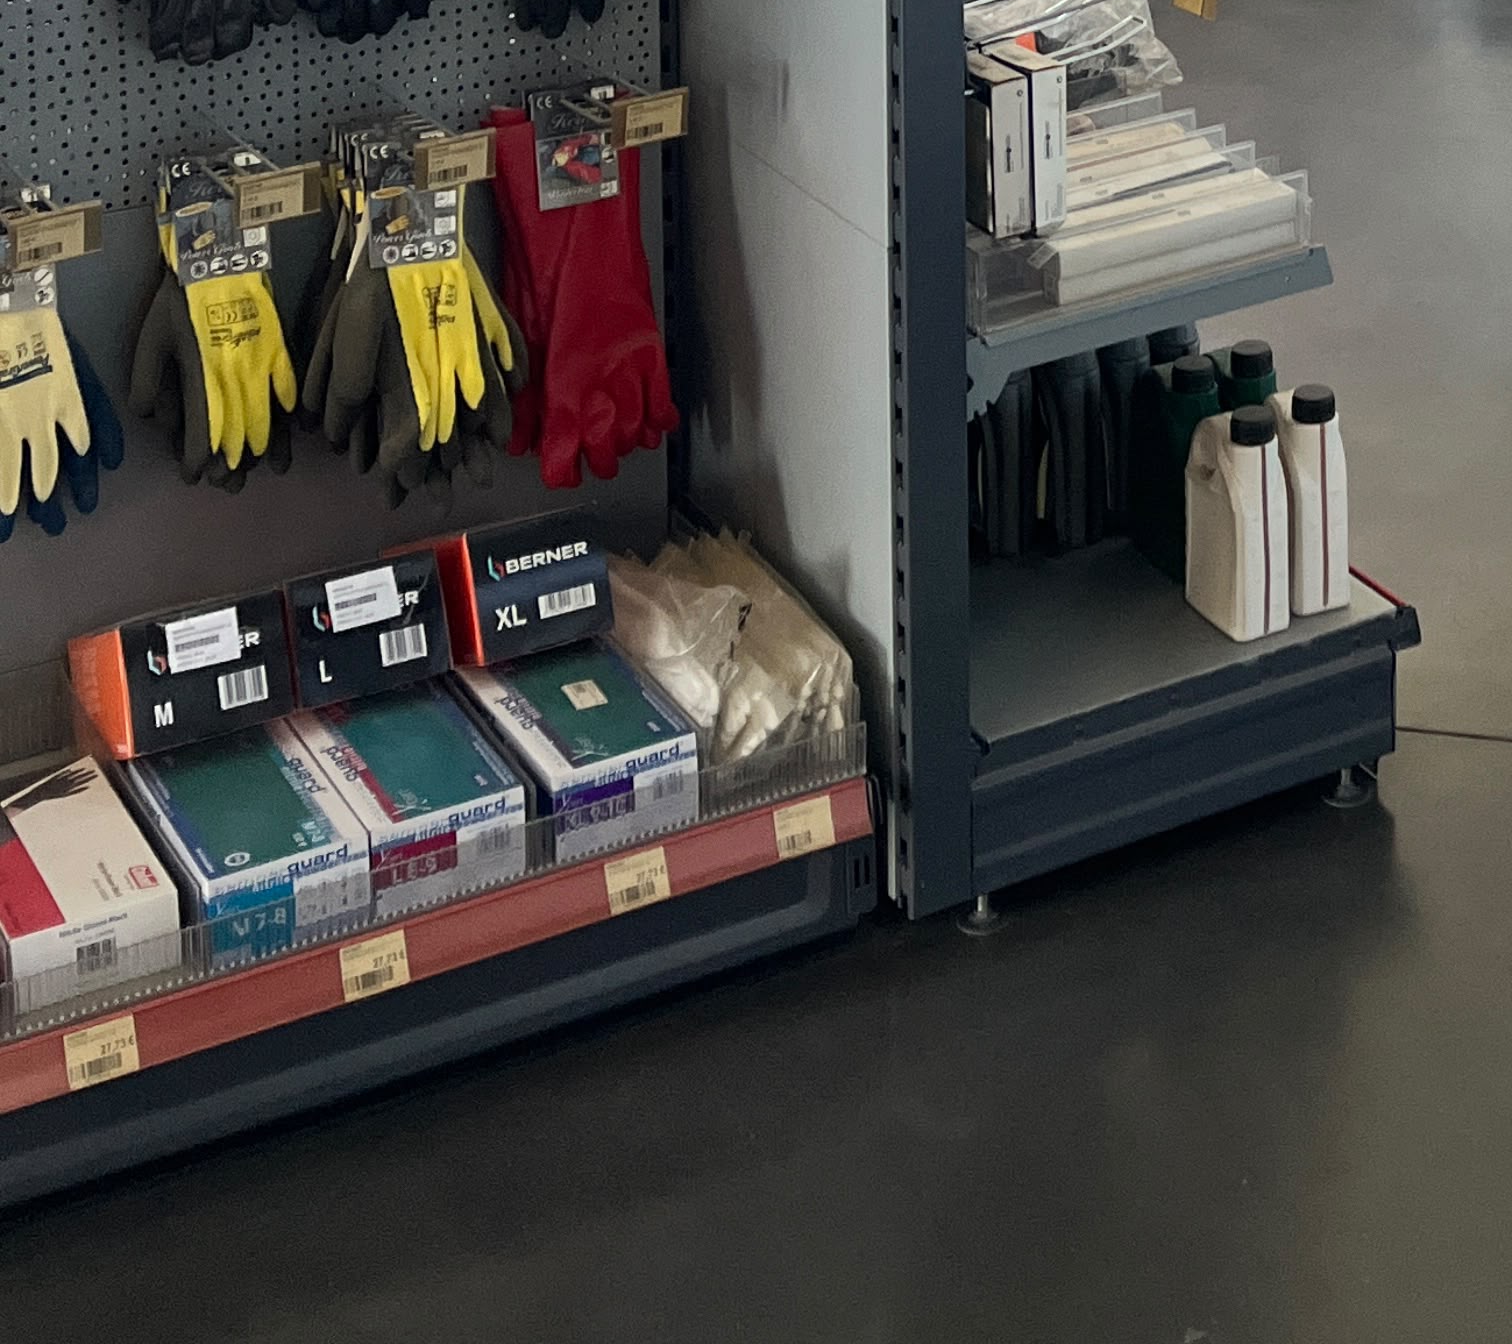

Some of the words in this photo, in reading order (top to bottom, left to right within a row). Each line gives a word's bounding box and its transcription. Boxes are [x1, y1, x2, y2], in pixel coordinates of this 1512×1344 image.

[505, 540, 588, 576] BERNER
[495, 603, 528, 632] XL
[318, 659, 333, 684] L
[153, 700, 175, 729] M
[626, 741, 681, 772] guard
[448, 796, 507, 829] guard
[287, 843, 348, 880] guard
